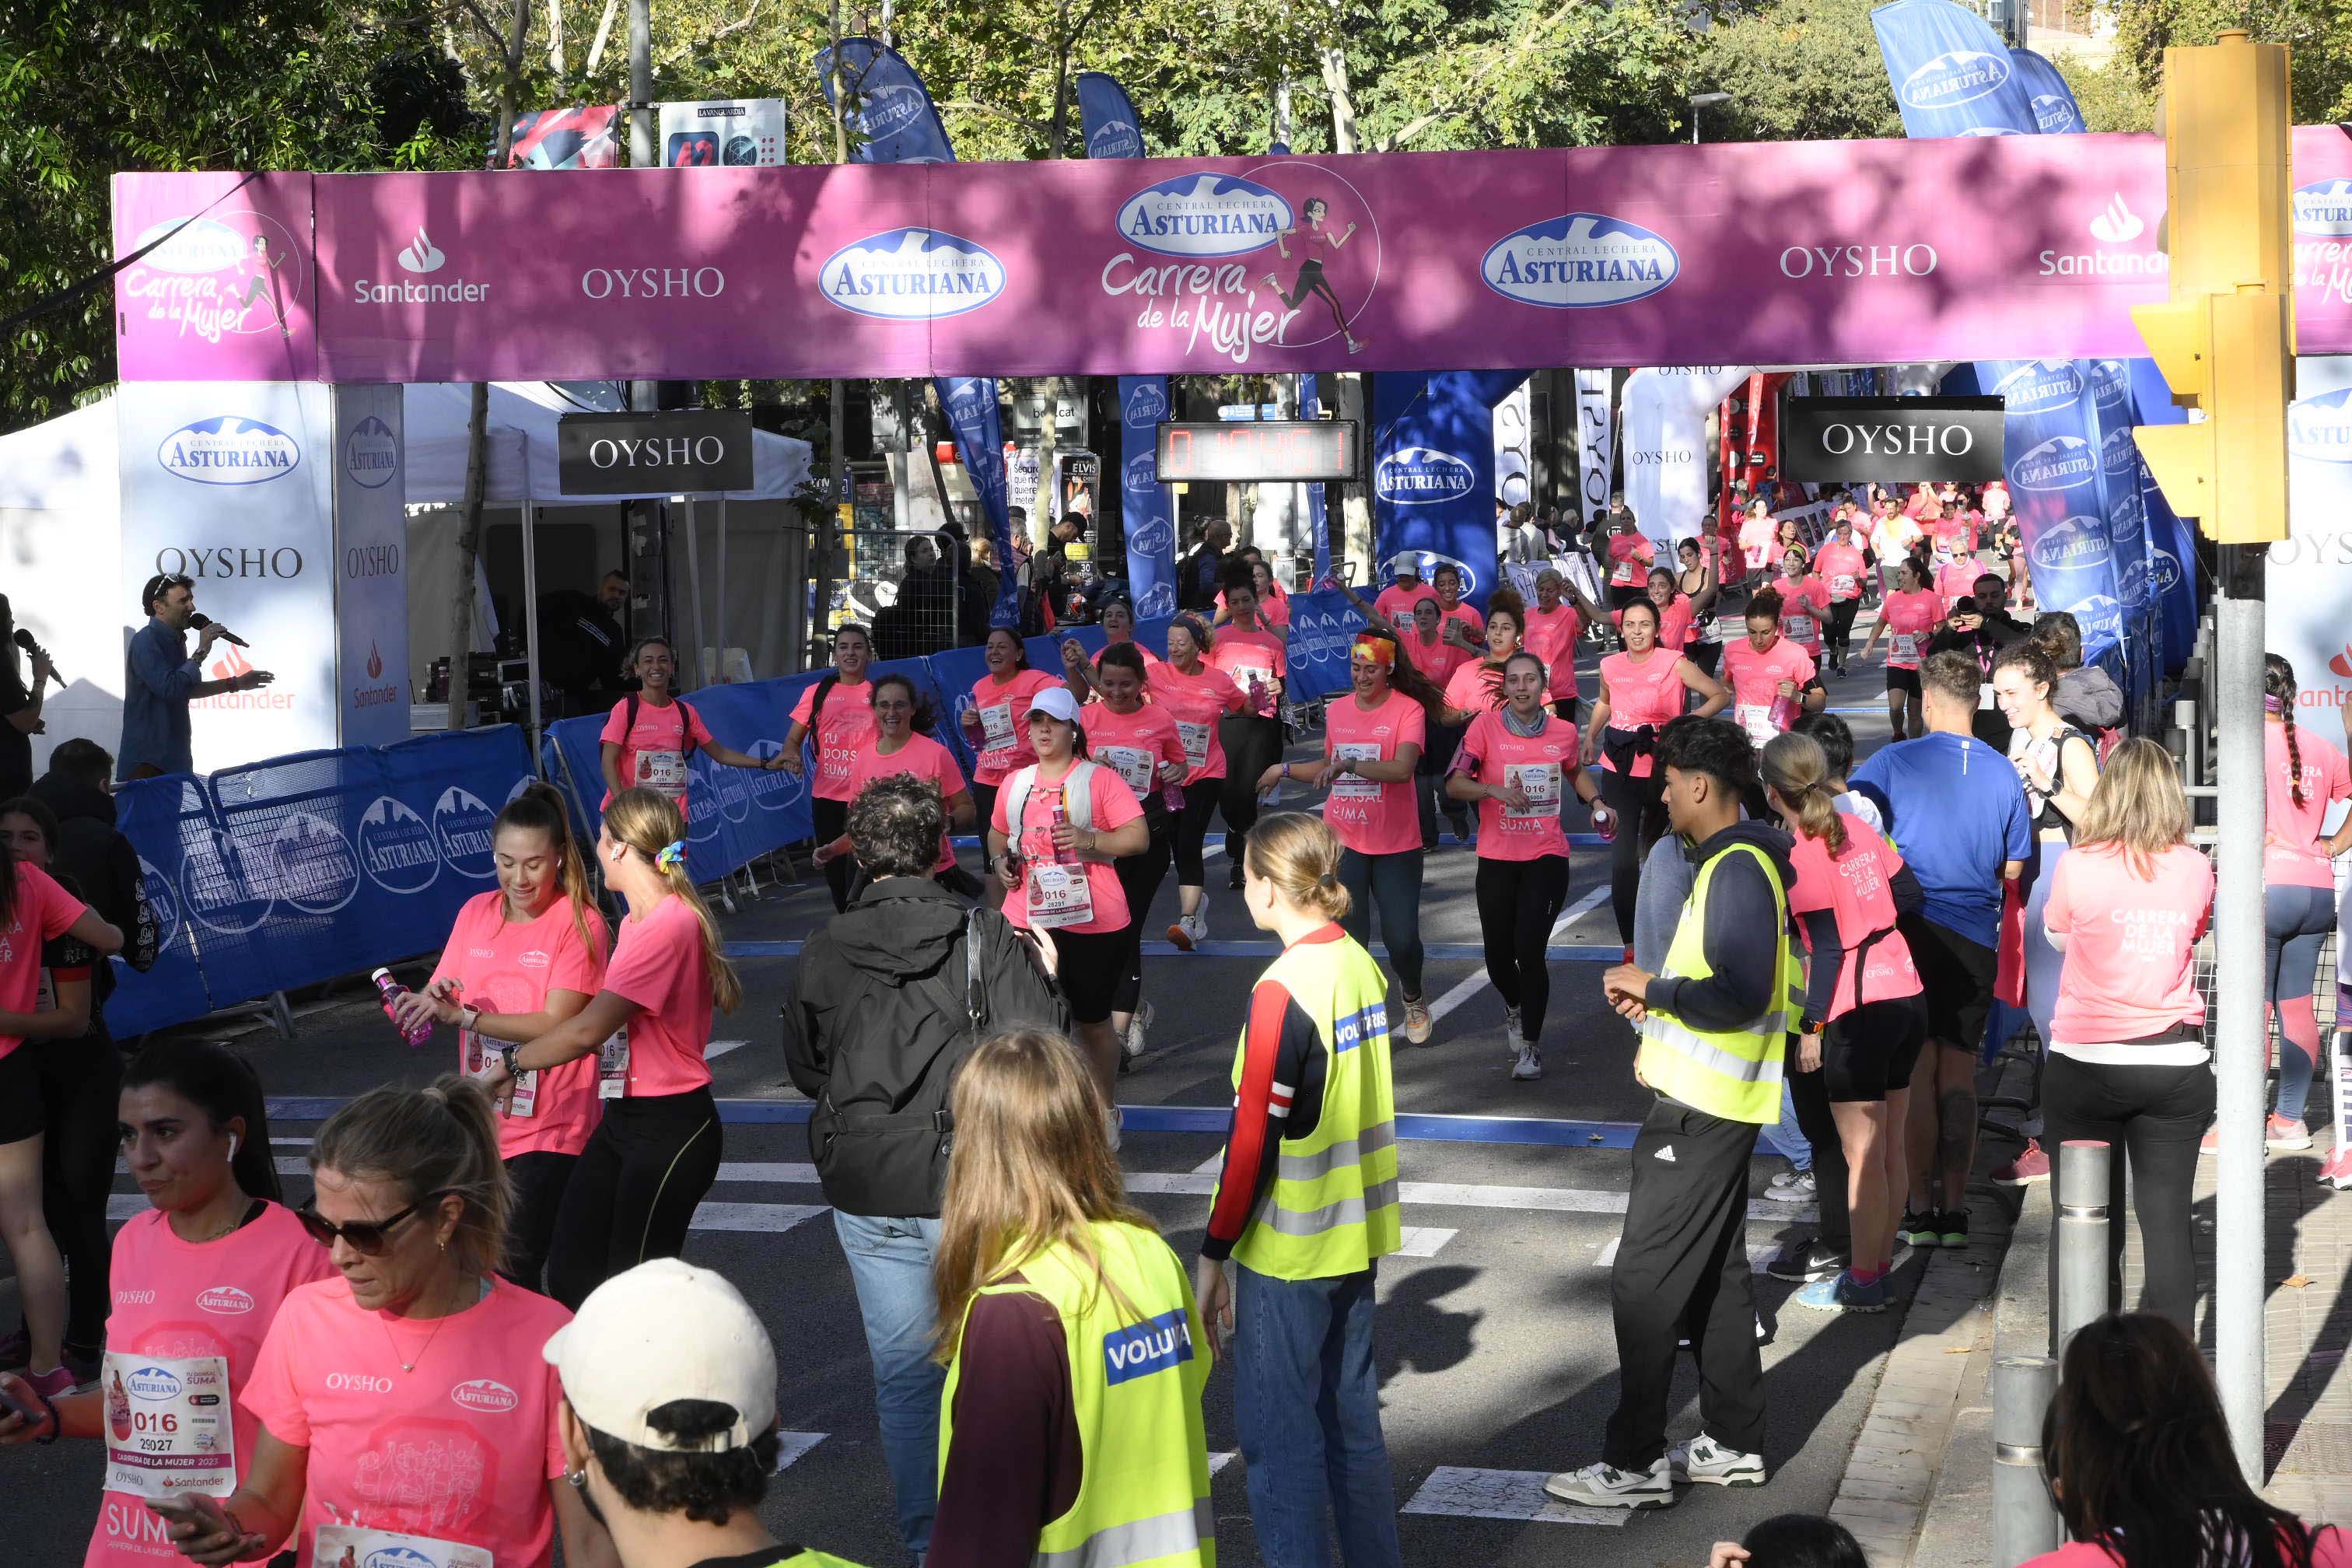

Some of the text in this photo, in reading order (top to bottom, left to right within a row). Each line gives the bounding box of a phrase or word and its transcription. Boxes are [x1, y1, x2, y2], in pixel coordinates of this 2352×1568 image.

[707, 107, 745, 116] VANGUARDIA
[1157, 200, 1275, 211] CENTRAL LECHERA
[1129, 205, 1279, 236] ASTURIANA
[1527, 244, 1657, 257] CENTRAL LECHERA
[862, 258, 985, 269] CENTRAL LECHERA
[1496, 250, 1664, 284] ASTURIANA
[1780, 243, 1937, 278] OYSHO
[124, 268, 219, 299] Carrera
[582, 266, 726, 299] OYSHO
[833, 261, 992, 296] ASTURIANA
[1101, 252, 1248, 296] Carrera
[355, 278, 490, 304] Santander
[148, 296, 253, 344] de la Mujer
[1136, 290, 1302, 363] de la Mujer
[1822, 422, 1973, 456] OYSHO
[169, 441, 291, 467] ASTURIANA
[589, 434, 725, 469] OYSHO
[1633, 449, 1692, 466] OYSHO
[1072, 463, 1097, 473] ELVIS
[1379, 471, 1468, 492] ASTURIANA
[156, 547, 303, 579] OYSHO
[347, 544, 399, 579] OYSHO
[1081, 564, 1090, 572] 30
[354, 684, 397, 709] Santander
[824, 733, 838, 745] TU
[824, 762, 852, 777] SUM
[979, 755, 1009, 768] SUMA
[1525, 785, 1545, 793] 016
[1499, 819, 1543, 831] SUMA
[369, 835, 435, 874] ASTURIANA
[1839, 849, 1878, 877] CARRERA
[1851, 866, 1875, 886] DE LA
[1045, 890, 1066, 900] 016
[1856, 877, 1881, 898] MUJER
[2111, 908, 2187, 926] CARRERA
[2125, 924, 2174, 940] DE LA
[2120, 937, 2176, 955] MUJER
[116, 1290, 155, 1304] OYSHO
[201, 1296, 250, 1310] ASTURIANA
[130, 1379, 177, 1394] ASTURIANA
[187, 1377, 217, 1385] SUMA
[326, 1372, 393, 1393] OYSHO
[457, 1388, 513, 1407] ASTURIANA
[135, 1412, 178, 1433] 016
[140, 1439, 173, 1451] 29027
[117, 1453, 142, 1464] CARRERA
[143, 1456, 151, 1465] DE
[152, 1457, 163, 1465] LA
[116, 1471, 143, 1486] OYSHO
[174, 1476, 224, 1487] Santander
[106, 1503, 177, 1545] SUM
